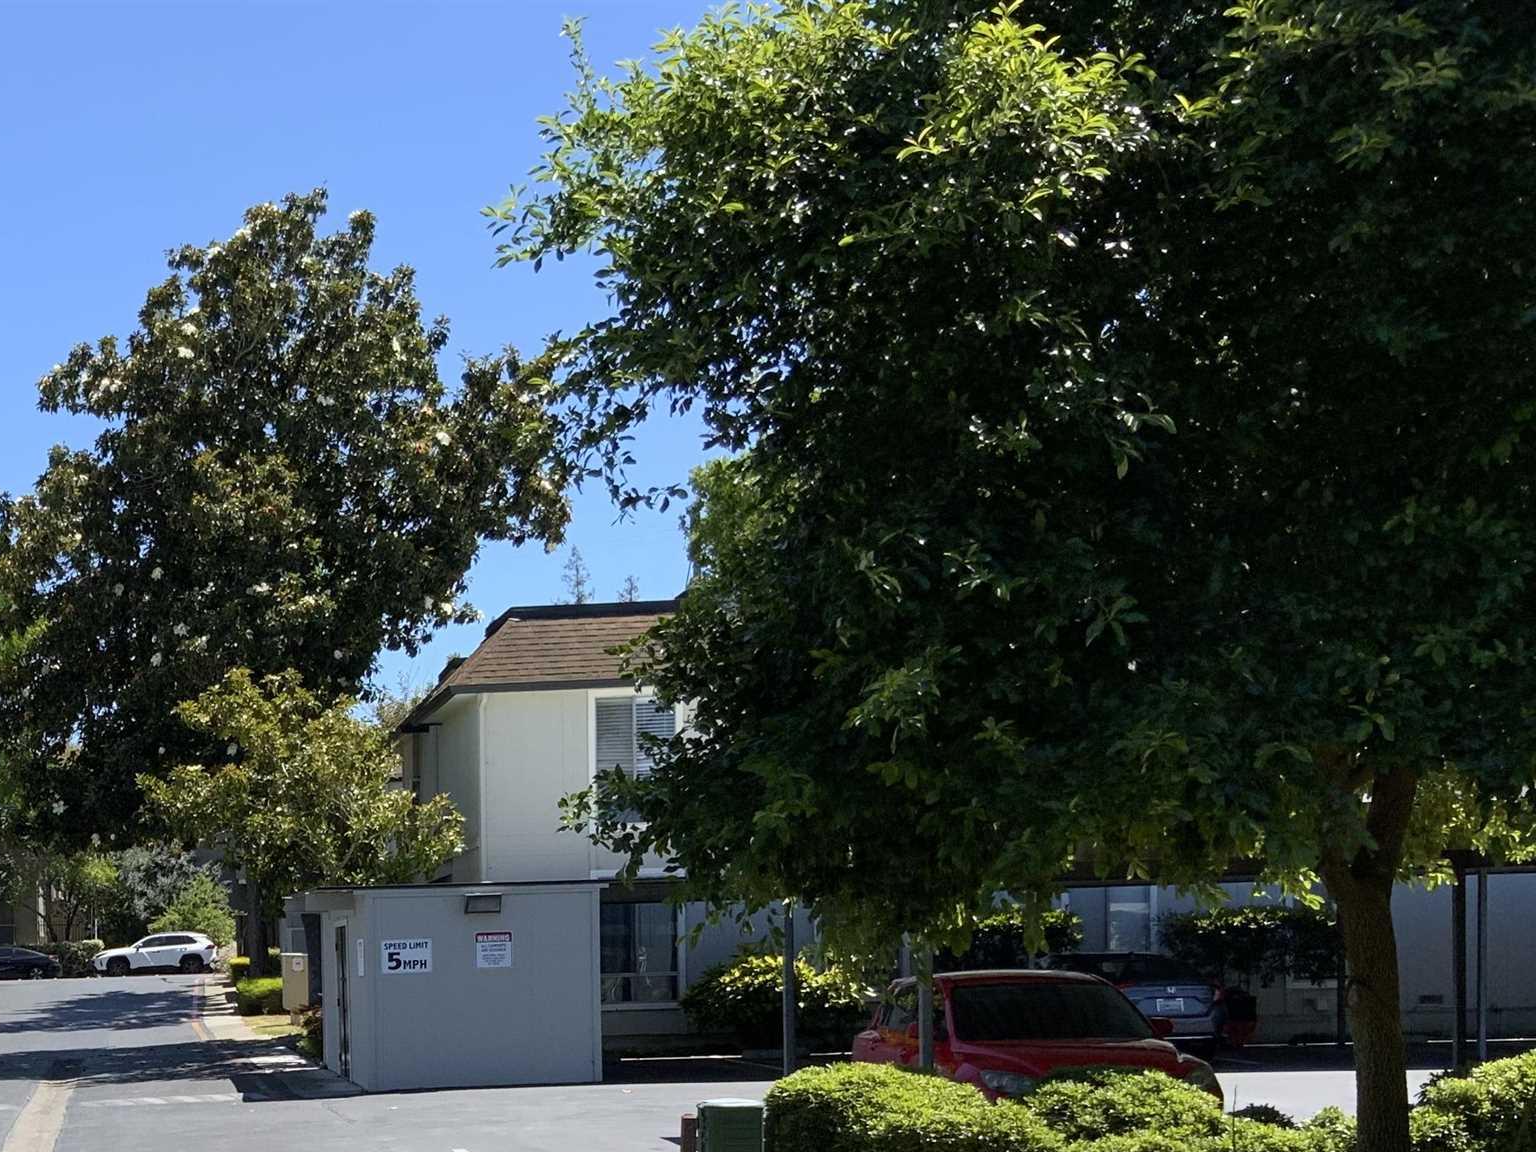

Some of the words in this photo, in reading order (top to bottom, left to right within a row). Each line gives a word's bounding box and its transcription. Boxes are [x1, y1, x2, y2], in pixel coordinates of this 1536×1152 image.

[477, 934, 510, 942] WARNING
[383, 942, 407, 951] SPEED
[409, 941, 429, 949] LIMIT
[388, 951, 402, 970] 5
[403, 959, 427, 970] MPH
